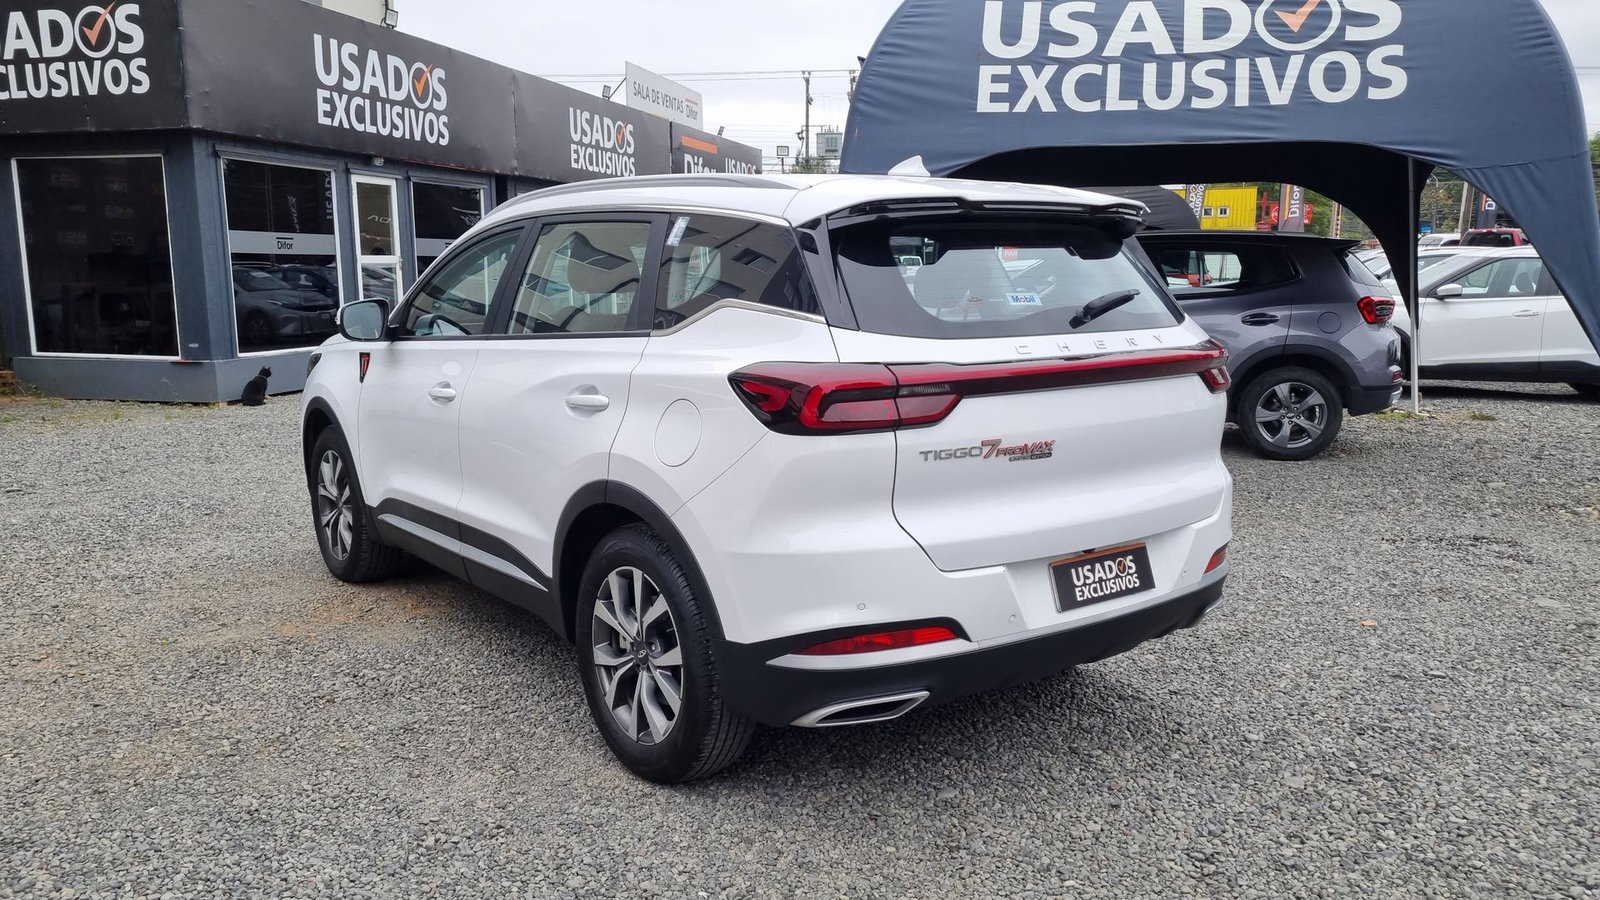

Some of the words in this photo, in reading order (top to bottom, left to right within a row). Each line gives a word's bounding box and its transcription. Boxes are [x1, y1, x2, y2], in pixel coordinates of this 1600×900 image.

[982, 0, 1402, 58] USADOS
[313, 33, 447, 111] USADOS
[976, 44, 1408, 113] EXCLUSIVOS
[632, 81, 650, 102] SALA
[652, 88, 660, 105] DE
[661, 92, 684, 114] VENTAS
[685, 104, 698, 120] Difor
[316, 88, 450, 146] EXCLUSIVOS
[569, 107, 635, 154] USADOS
[570, 143, 636, 177] EXCLUSIVOS
[1288, 186, 1300, 218] Difor
[277, 241, 294, 250] Difor
[1011, 295, 1036, 303] Mobil
[1014, 334, 1164, 355] CHERY
[919, 446, 983, 462] TIGGO
[1071, 555, 1137, 587] USADOS
[1074, 573, 1140, 602] EXCLUSIVOS
